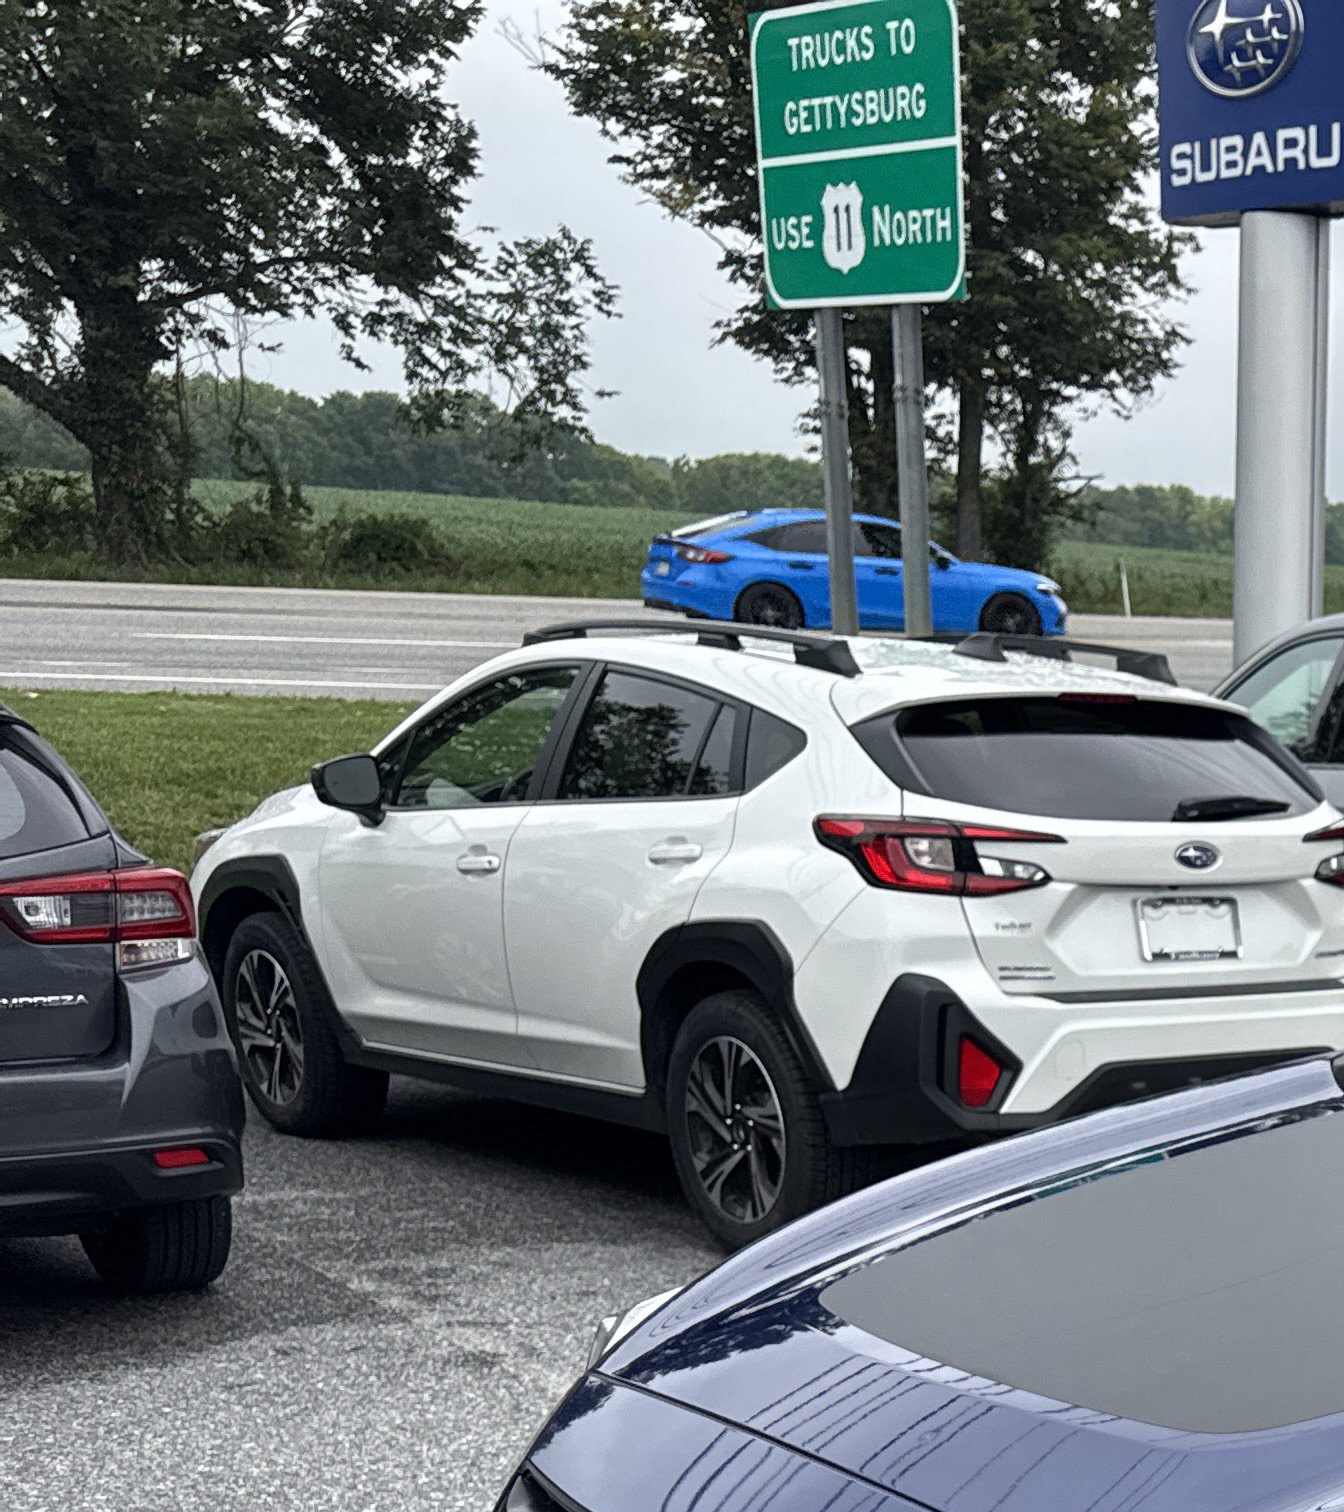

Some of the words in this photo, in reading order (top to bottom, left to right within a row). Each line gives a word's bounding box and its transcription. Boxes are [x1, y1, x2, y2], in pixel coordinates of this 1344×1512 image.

[787, 25, 875, 72] TRUCKS
[885, 18, 916, 56] TO
[784, 83, 927, 135] GETTYSBURG
[1170, 122, 1342, 187] SUBARU
[772, 215, 815, 250] USE
[833, 203, 852, 252] 11
[871, 204, 952, 247] NORTH
